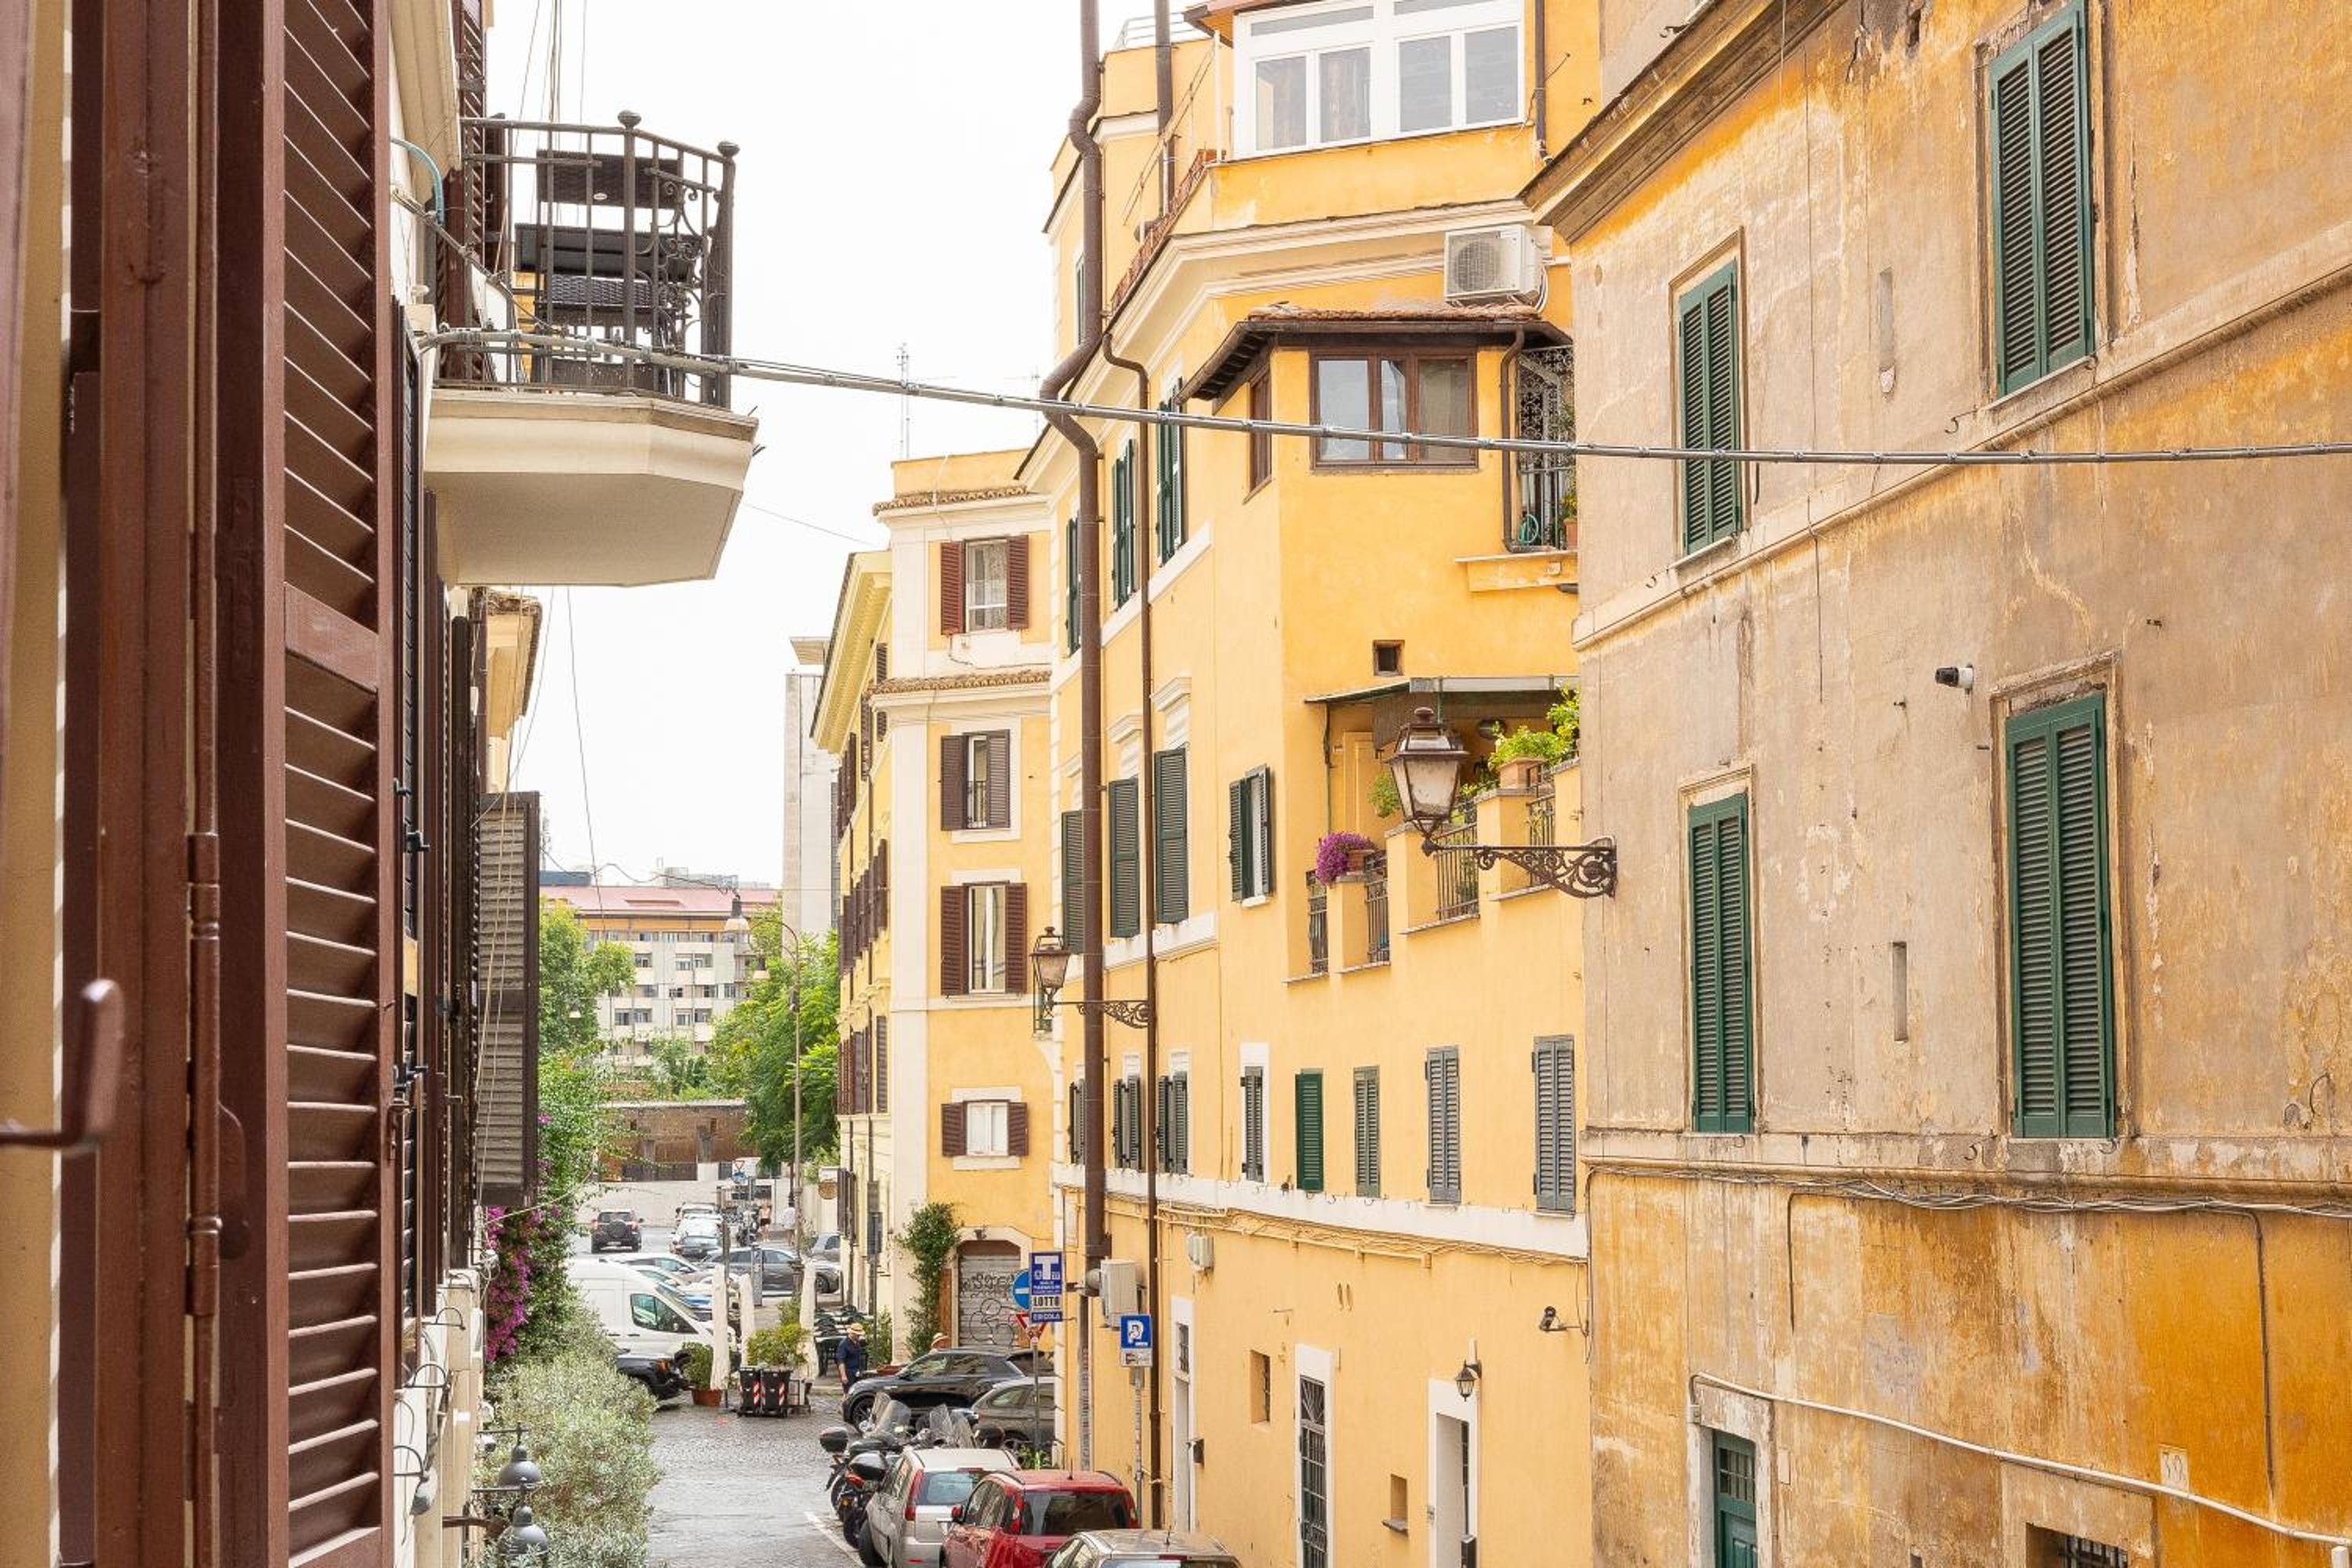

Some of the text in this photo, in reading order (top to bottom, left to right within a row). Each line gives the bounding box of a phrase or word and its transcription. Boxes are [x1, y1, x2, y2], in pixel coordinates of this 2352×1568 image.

[1035, 1256, 1059, 1280] T
[1033, 1296, 1060, 1306] LOTTO
[1127, 1320, 1144, 1344] P
